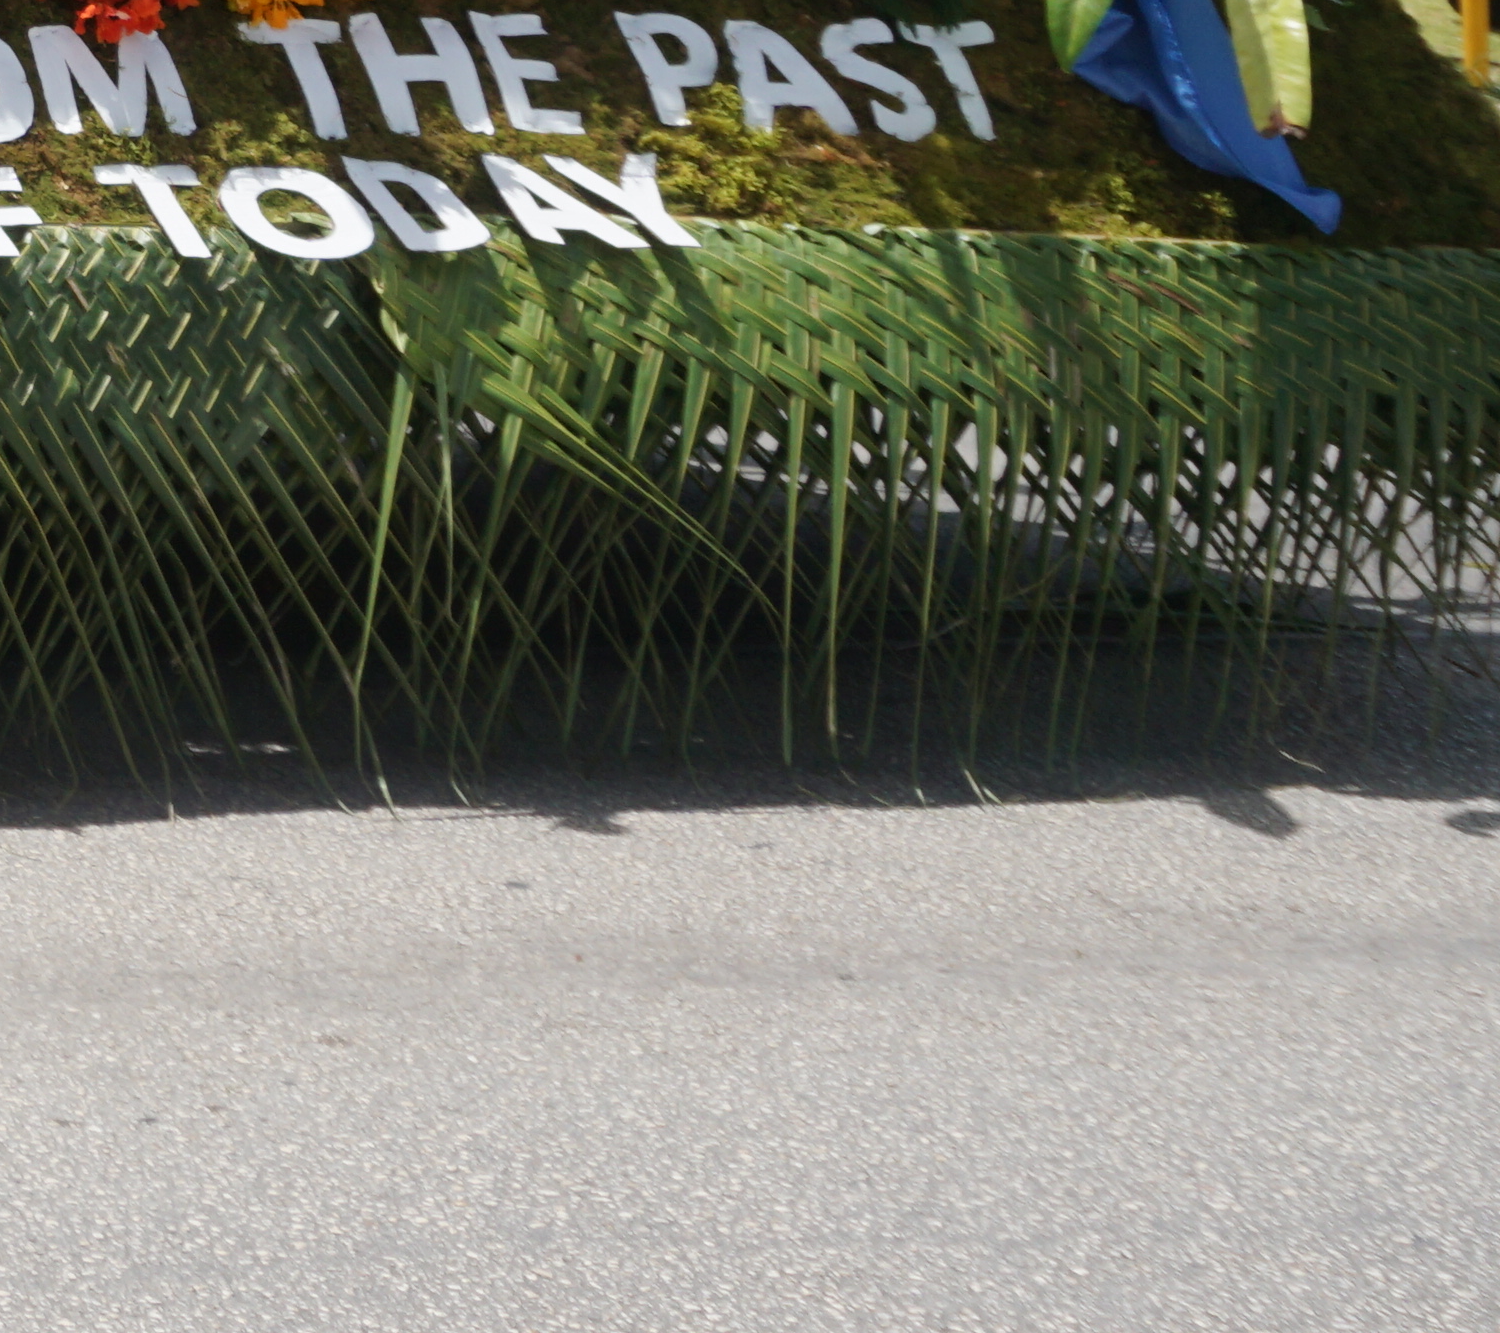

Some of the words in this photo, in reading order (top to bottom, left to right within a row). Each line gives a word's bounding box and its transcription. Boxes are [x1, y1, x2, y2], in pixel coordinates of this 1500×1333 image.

[237, 11, 586, 140] THE
[613, 10, 996, 142] PAST
[93, 152, 702, 259] TODAY
